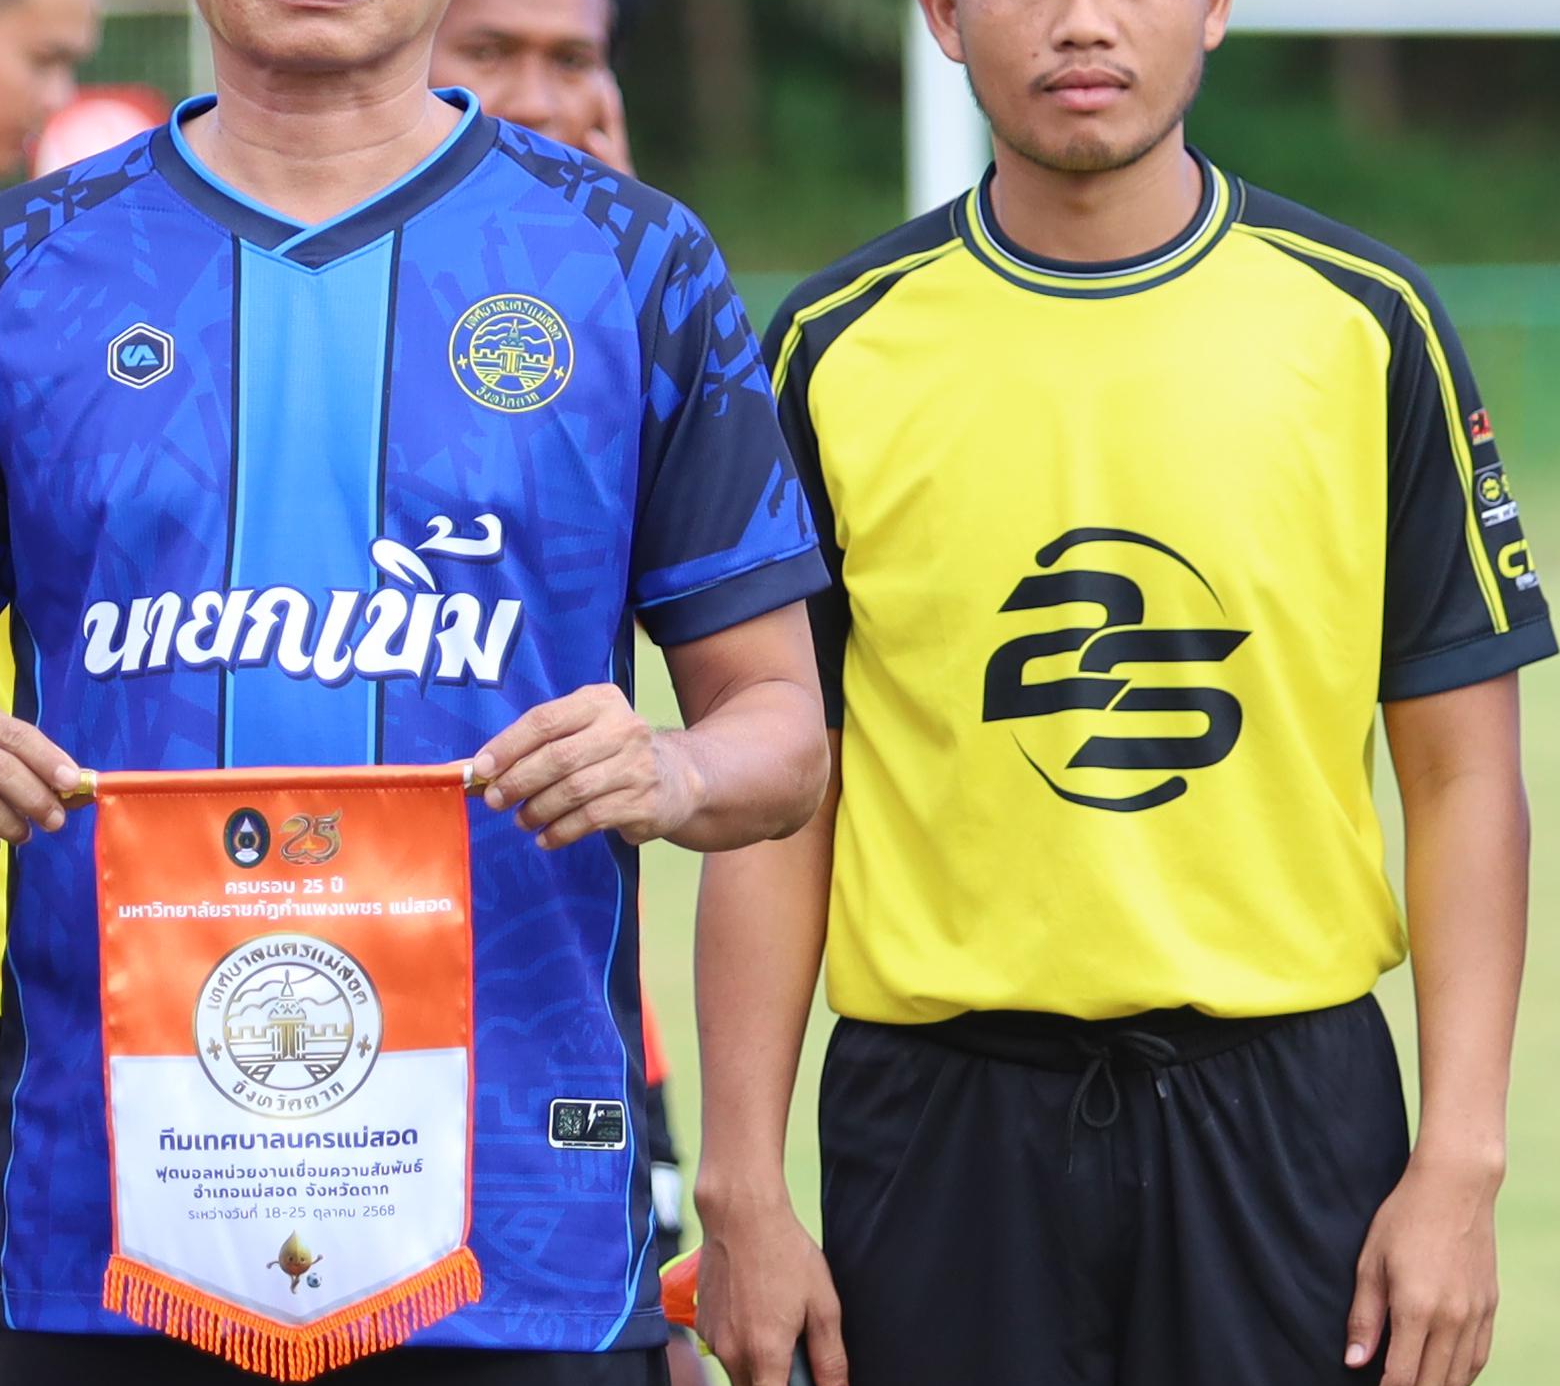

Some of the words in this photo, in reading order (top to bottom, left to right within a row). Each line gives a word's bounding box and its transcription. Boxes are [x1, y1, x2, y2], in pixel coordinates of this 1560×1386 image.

[225, 879, 296, 895] ครบรอบ
[302, 879, 324, 894] 25
[331, 876, 344, 894] ปี
[389, 896, 452, 915] แม่สอด
[207, 943, 368, 1010] เทศบาลนครแม่สอด
[232, 1080, 345, 1111] จังหวัดตาก
[159, 1125, 419, 1151] ทีมเทศบาลนครแม่สอด
[155, 1158, 424, 1184] ฟุตบอลหน่วยงานเชื่อมความสัมพันธ์
[193, 1183, 297, 1199] อำเภอแม่สอด
[305, 1182, 389, 1198] จังหวัดตาก
[187, 1204, 258, 1221] ระหว่างวันที่
[264, 1207, 306, 1219] 18-25
[313, 1207, 356, 1221] ตุลาคม
[362, 1204, 396, 1217] 2568
